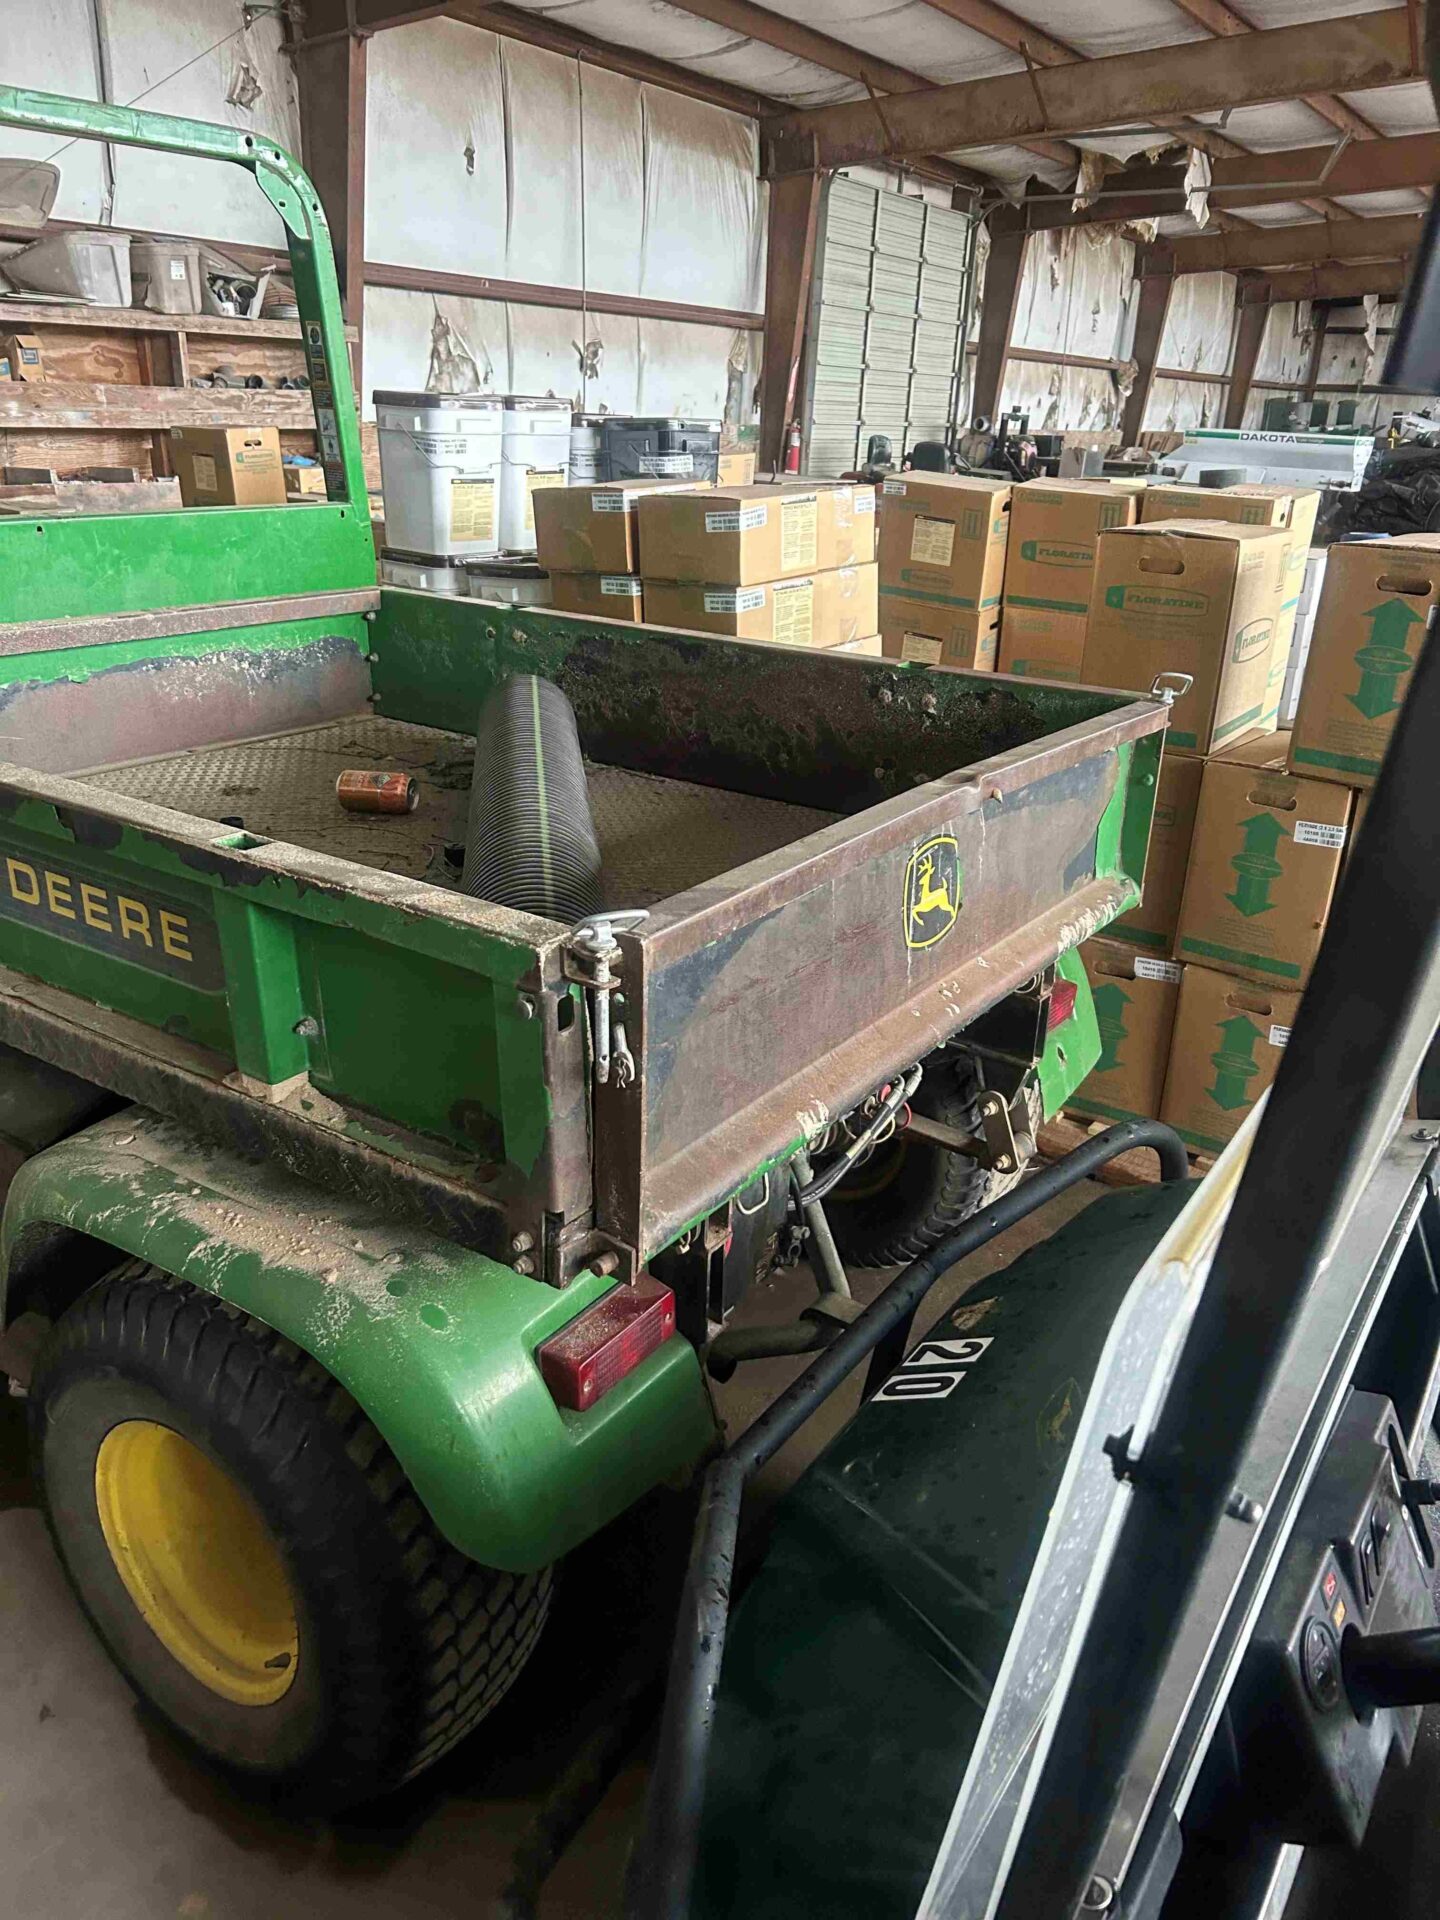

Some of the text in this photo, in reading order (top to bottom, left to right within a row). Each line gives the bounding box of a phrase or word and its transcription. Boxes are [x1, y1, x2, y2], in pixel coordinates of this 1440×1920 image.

[1241, 433, 1296, 444] DAKOTA
[1127, 594, 1204, 609] FLORATINE
[1241, 628, 1271, 650] FLORATINE
[6, 857, 193, 962] DEERE
[881, 1341, 984, 1397] 20
